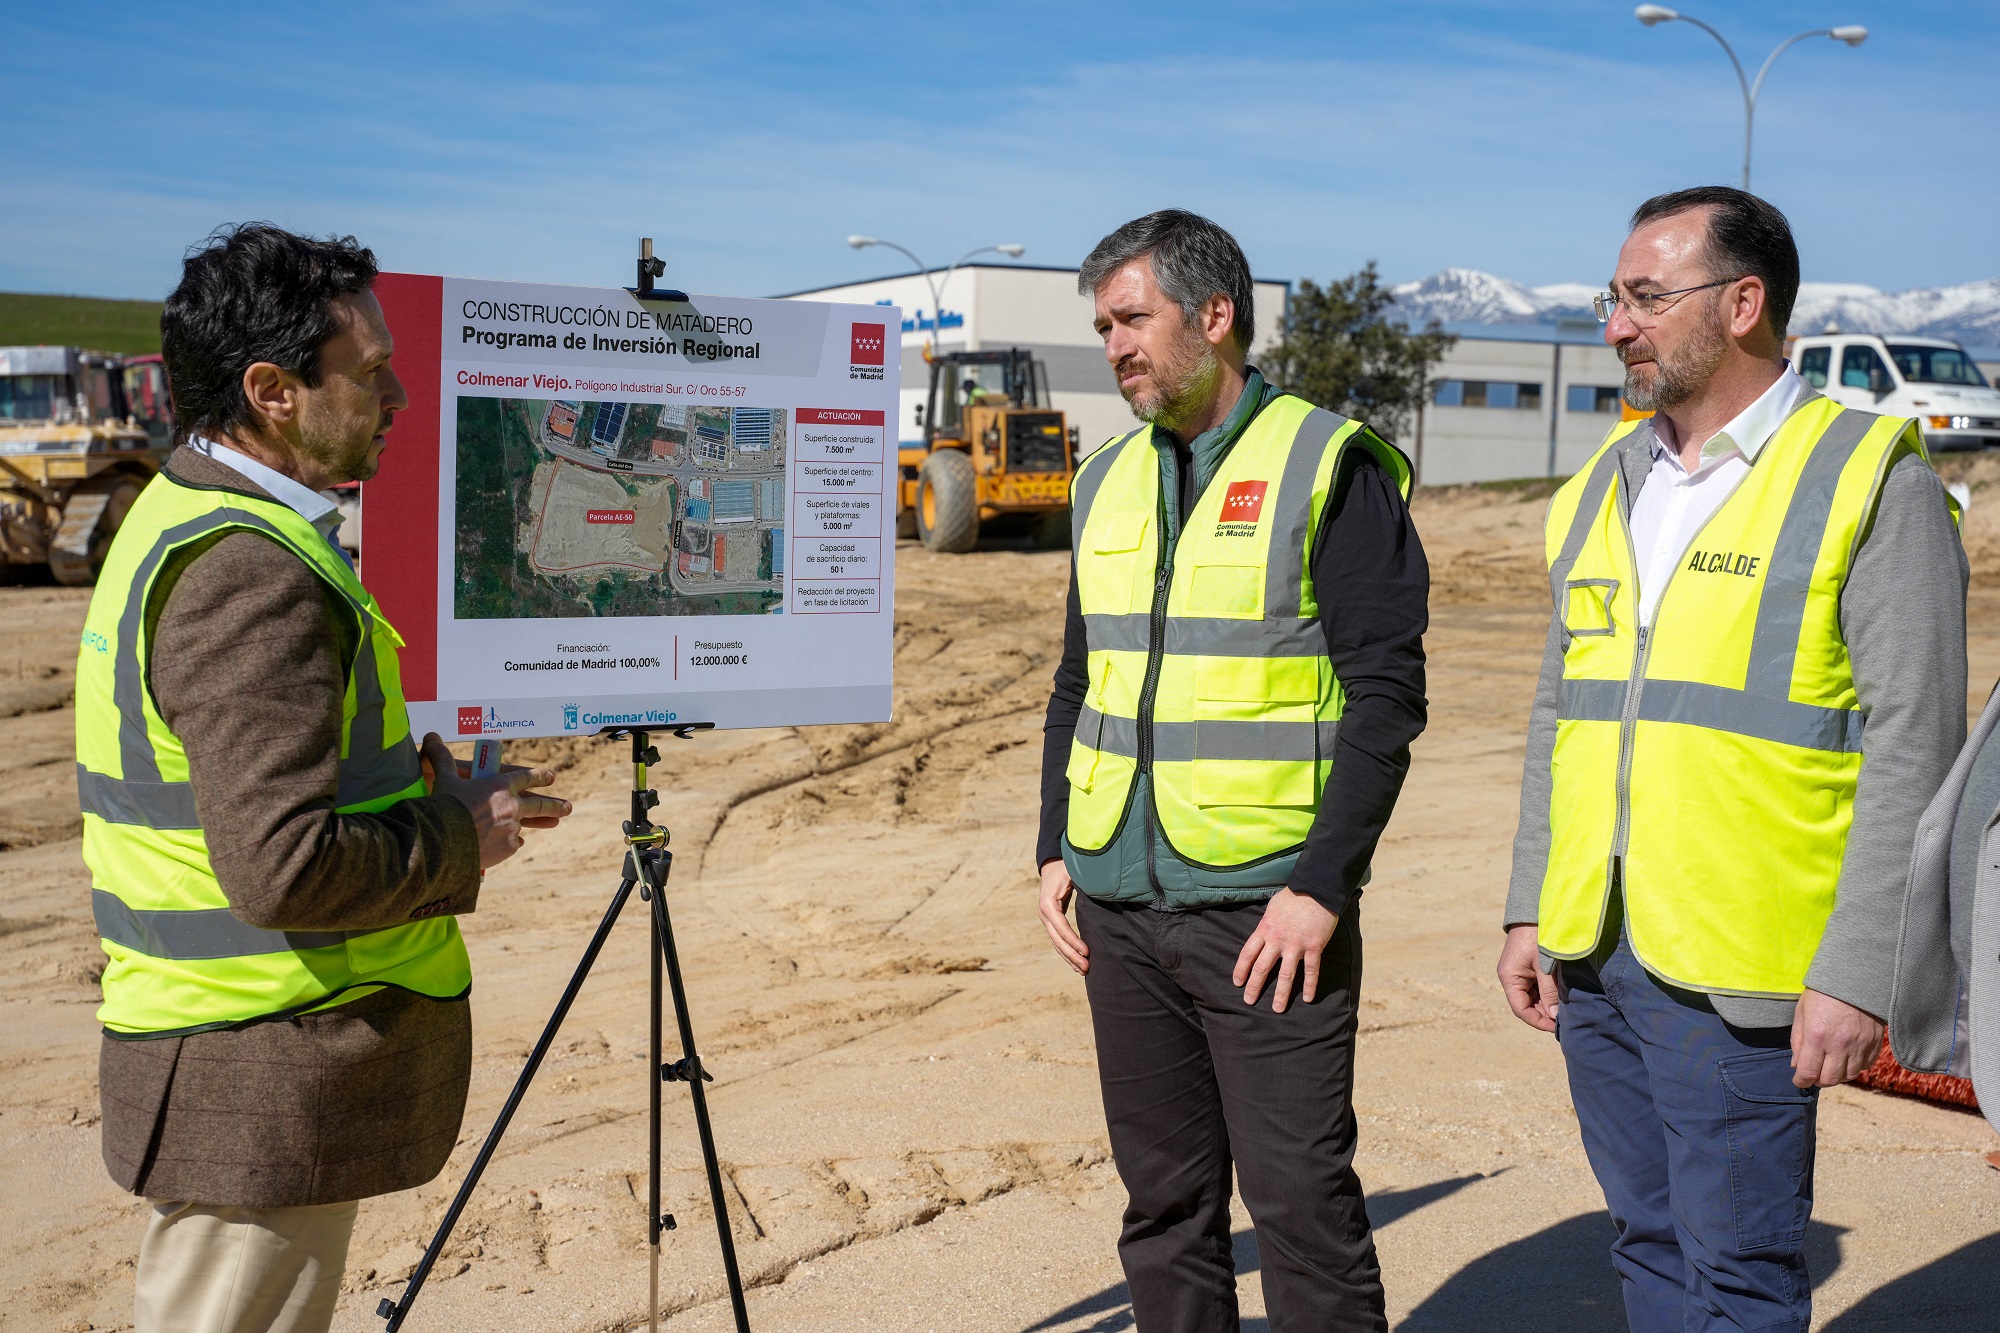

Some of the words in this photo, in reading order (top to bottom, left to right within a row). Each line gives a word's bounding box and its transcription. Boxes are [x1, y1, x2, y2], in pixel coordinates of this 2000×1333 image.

[463, 300, 620, 328] CONSTRUCCIÓN
[626, 311, 651, 330] DE
[656, 313, 752, 335] MATADERO
[462, 326, 557, 351] Programa
[563, 333, 586, 350] de
[593, 334, 677, 356] Inversión
[684, 340, 760, 359] Regional
[457, 371, 529, 389] Colmenar
[533, 374, 572, 392] Viejo.
[575, 379, 617, 394] Polígono
[621, 380, 664, 394] Industrial
[666, 382, 684, 394] Sur.
[686, 383, 698, 396] C/
[701, 385, 718, 396] Oro
[720, 386, 747, 398] 55-57
[817, 411, 861, 421] ACTUACIÓN
[804, 434, 838, 444] Superficie
[839, 435, 876, 444] construida:
[825, 445, 844, 454] 7.500
[845, 446, 855, 454] m²
[804, 467, 838, 476] Superficie
[839, 468, 850, 476] del
[822, 479, 845, 487] 15.000
[846, 479, 856, 487] m²
[806, 500, 840, 509] Superficie
[841, 501, 850, 509] de
[851, 501, 870, 509] viales
[589, 513, 613, 522] Parcela
[614, 513, 633, 522] AE-50
[820, 512, 861, 520] plataformas:
[823, 522, 842, 530] 5.000
[843, 522, 853, 530] m²
[819, 544, 855, 553] Capacidad
[806, 555, 815, 563] de
[816, 555, 846, 563] sacrificio
[847, 555, 868, 563] diario:
[1688, 551, 1760, 577] ALCALDE
[798, 587, 833, 596] Redacción
[834, 588, 845, 596] del
[846, 588, 875, 597] proyecto
[814, 598, 828, 606] fase
[829, 598, 838, 606] de
[839, 597, 869, 606] licitación
[557, 643, 611, 653] Financiación:
[694, 640, 743, 651] Presupuesto
[504, 660, 564, 671] Comunidad
[566, 660, 579, 670] de
[581, 658, 617, 669] Madrid
[620, 657, 660, 669] 100,00%
[690, 655, 739, 666] 12.000.000
[741, 655, 748, 664] €
[582, 712, 643, 725] Colmenar
[645, 710, 677, 724] Viejo
[483, 720, 535, 729] PLANIFICA
